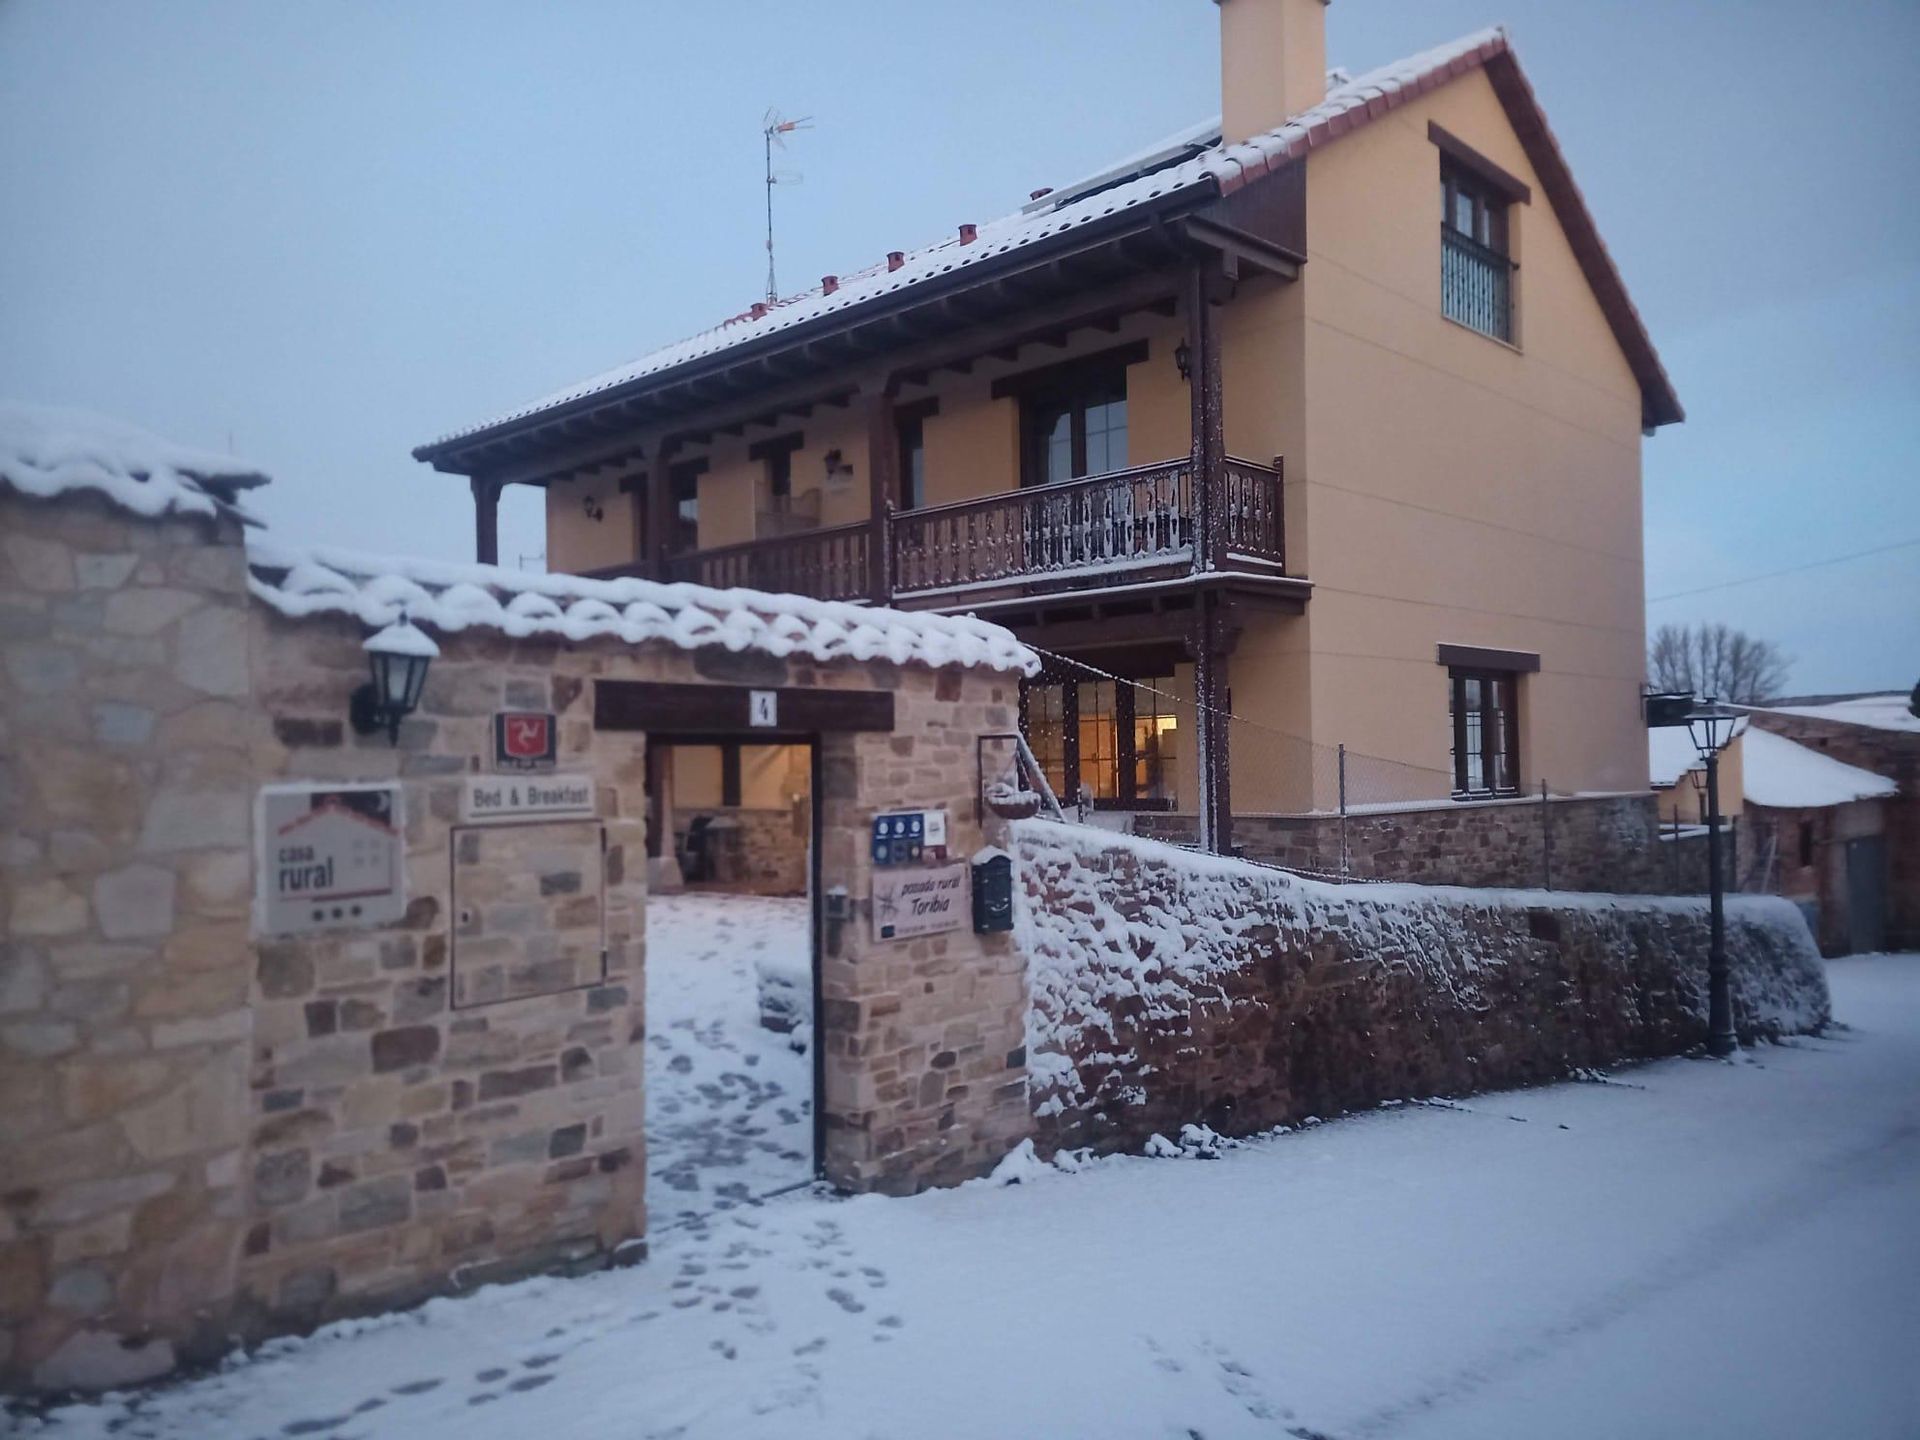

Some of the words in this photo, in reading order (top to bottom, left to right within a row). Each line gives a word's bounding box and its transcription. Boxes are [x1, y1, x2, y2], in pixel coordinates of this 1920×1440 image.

[759, 697, 769, 721] 4
[473, 788, 502, 807] Bed
[510, 787, 520, 805] &
[527, 785, 589, 805] Breakfast
[279, 845, 314, 864] casa
[279, 856, 333, 891] rural
[937, 875, 961, 889] rural
